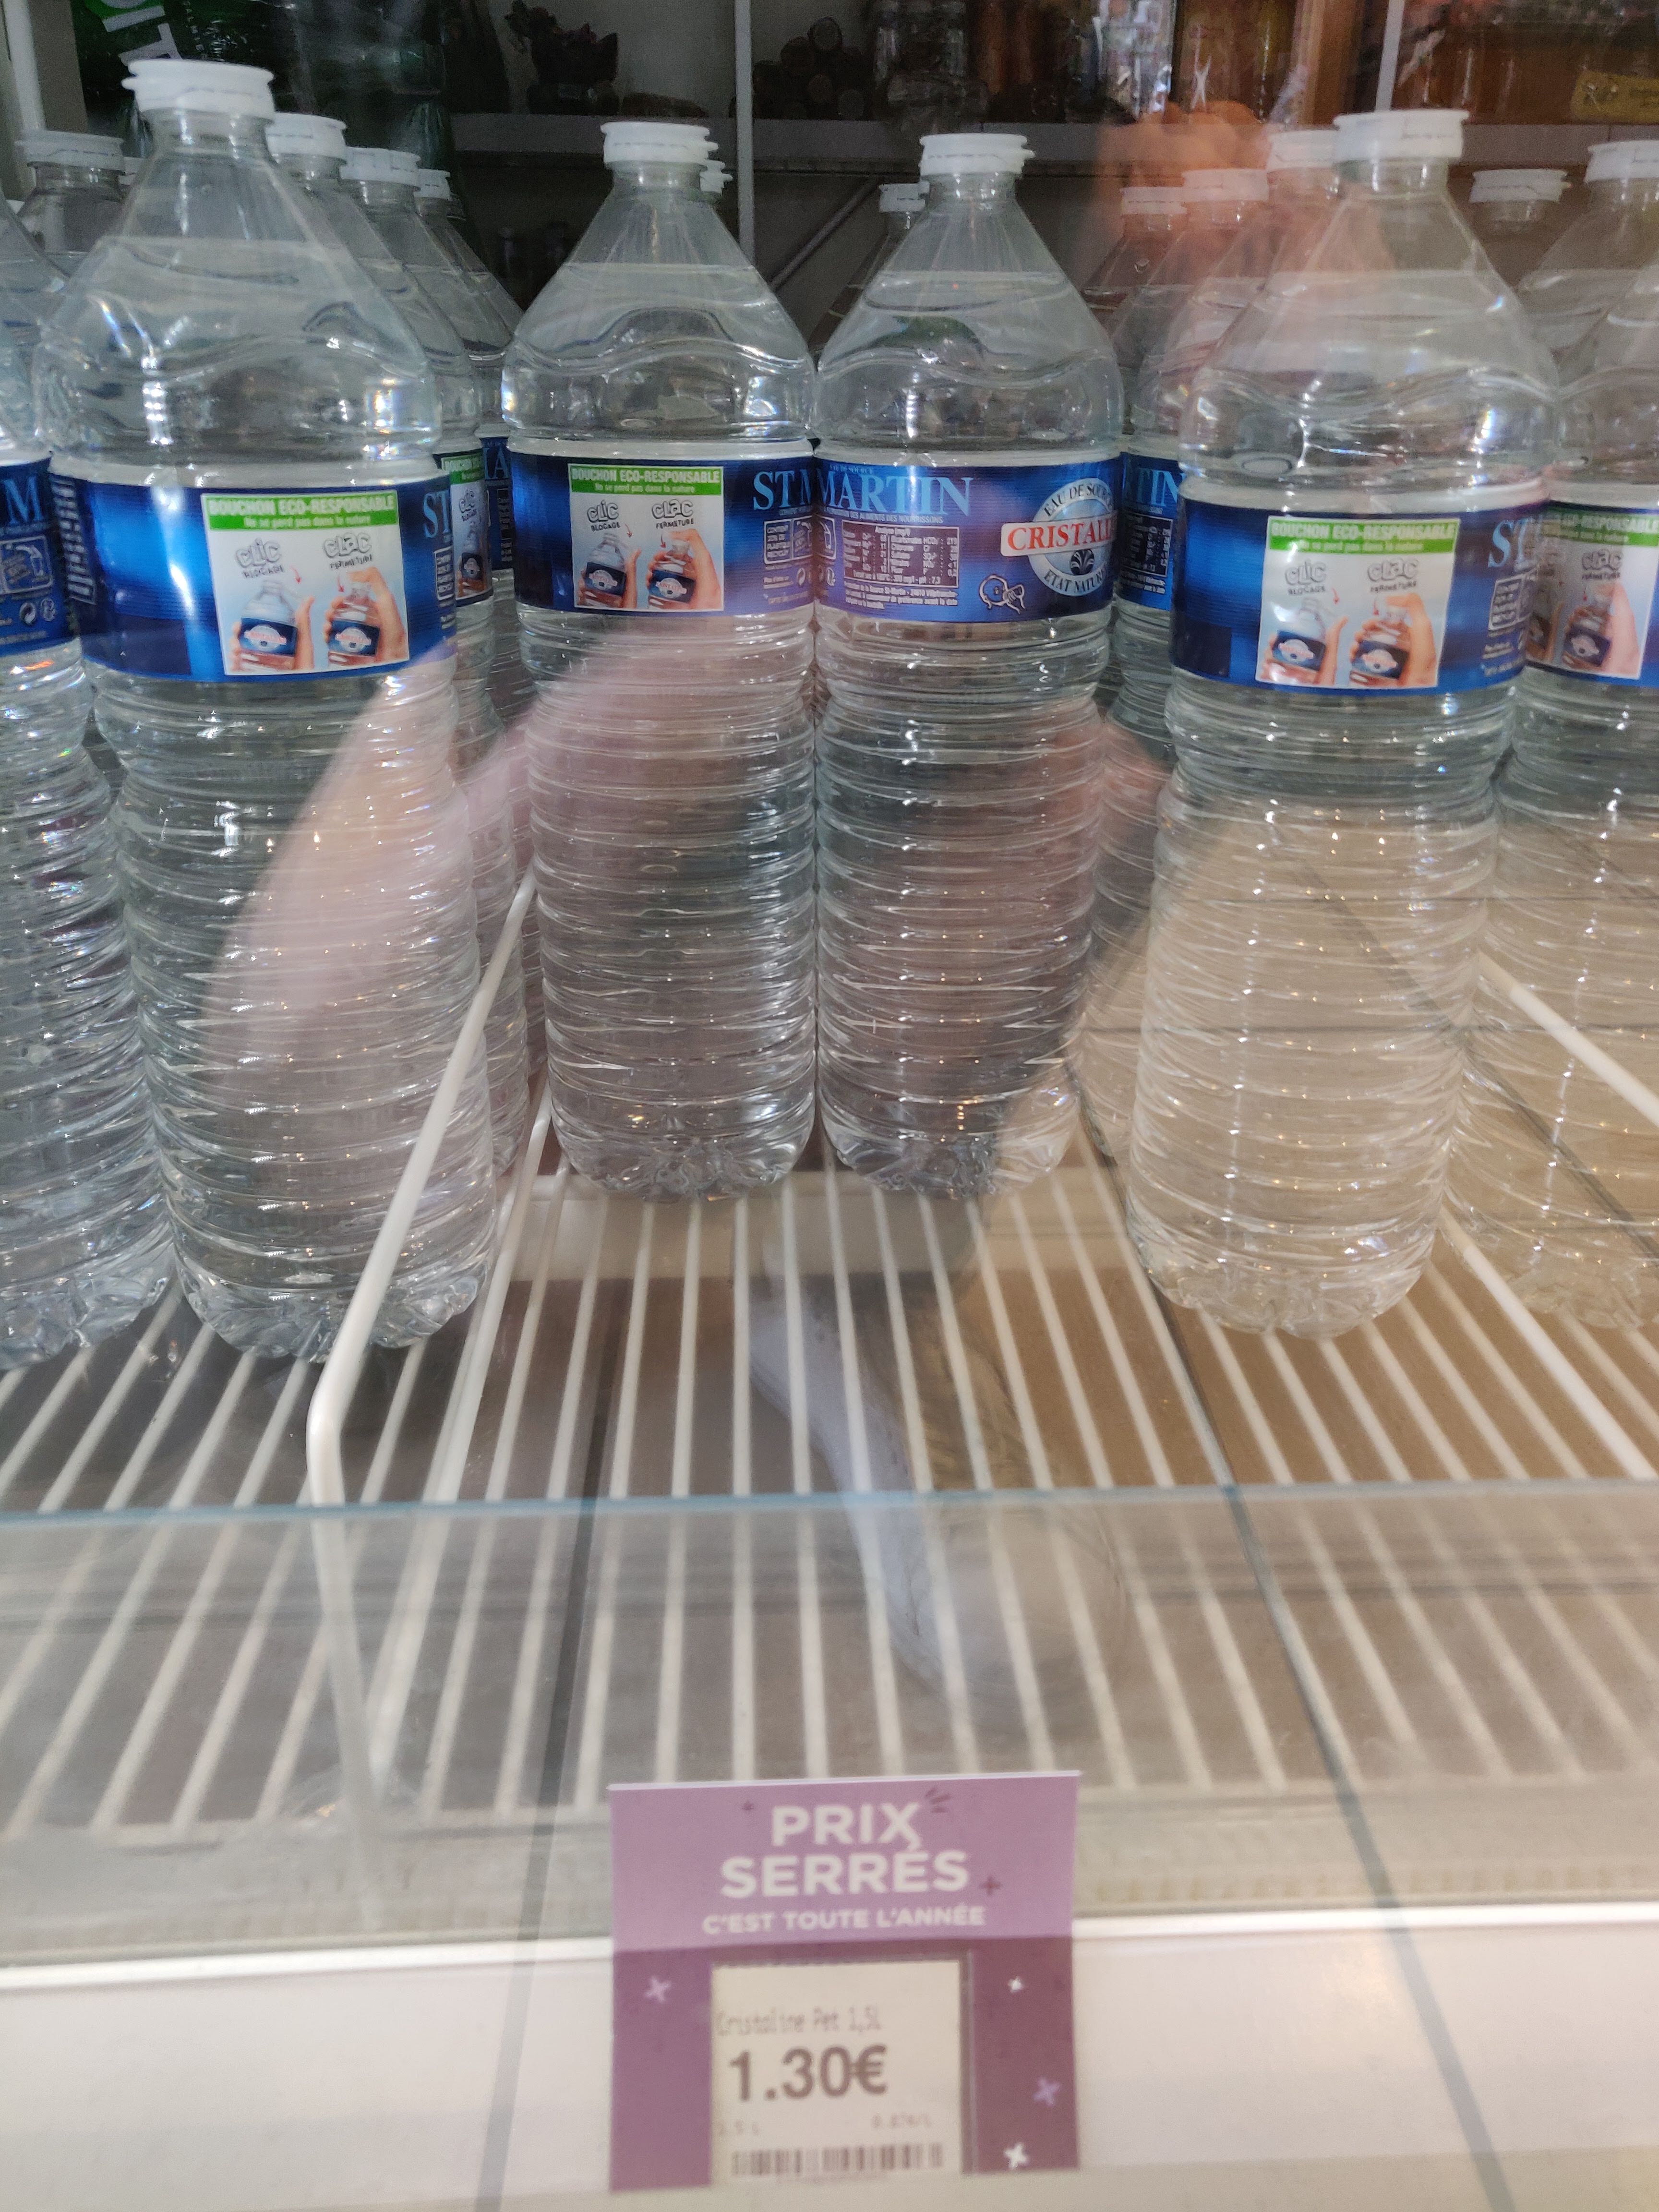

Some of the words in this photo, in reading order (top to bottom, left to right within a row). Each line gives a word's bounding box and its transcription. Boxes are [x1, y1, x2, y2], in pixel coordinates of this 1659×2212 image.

[772, 1802, 921, 1846] PRIX
[702, 1912, 775, 1935] C'EST
[782, 1909, 869, 1930] TOUTE
[877, 1903, 986, 1927] L'ANNÉE
[729, 2044, 889, 2102] 1.30€
